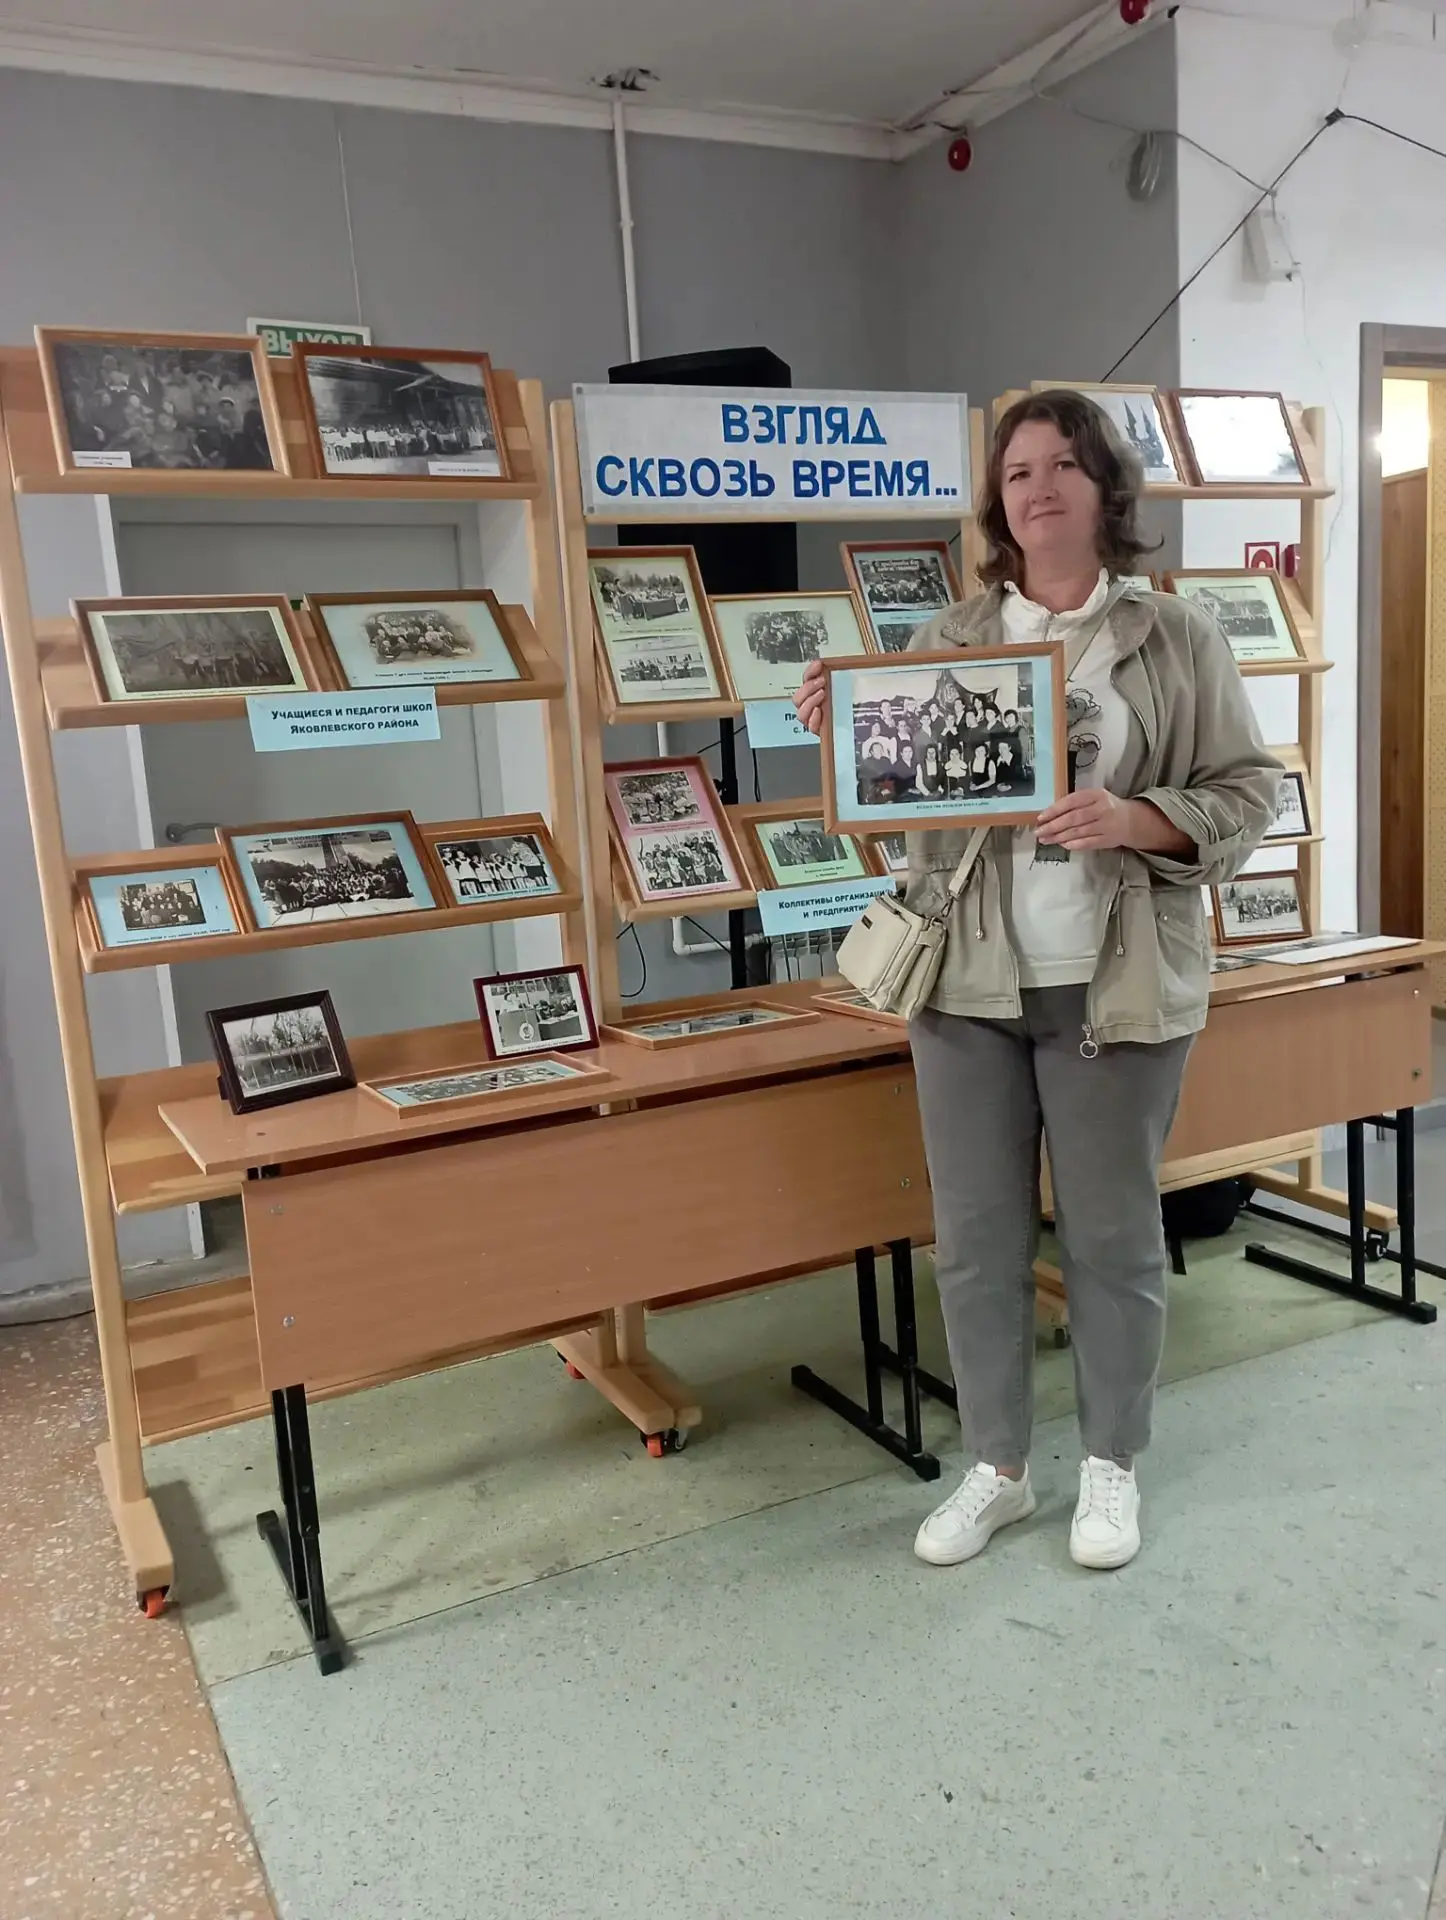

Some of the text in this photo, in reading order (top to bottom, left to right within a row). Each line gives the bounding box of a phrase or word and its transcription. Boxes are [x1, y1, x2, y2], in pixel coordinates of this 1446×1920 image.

[721, 403, 887, 445] ВЗГЛЯД
[596, 455, 957, 498] СКВОЗЬ ВРЕМЯ...
[271, 703, 433, 720] УЧАЩИЕСЯ И ПЕДАГОГИ ШКОЛ
[290, 718, 419, 734] ЯКОВЛЕВСКОГО РАЙОНА
[778, 896, 833, 909] КОЛЛЕКТИВЫ
